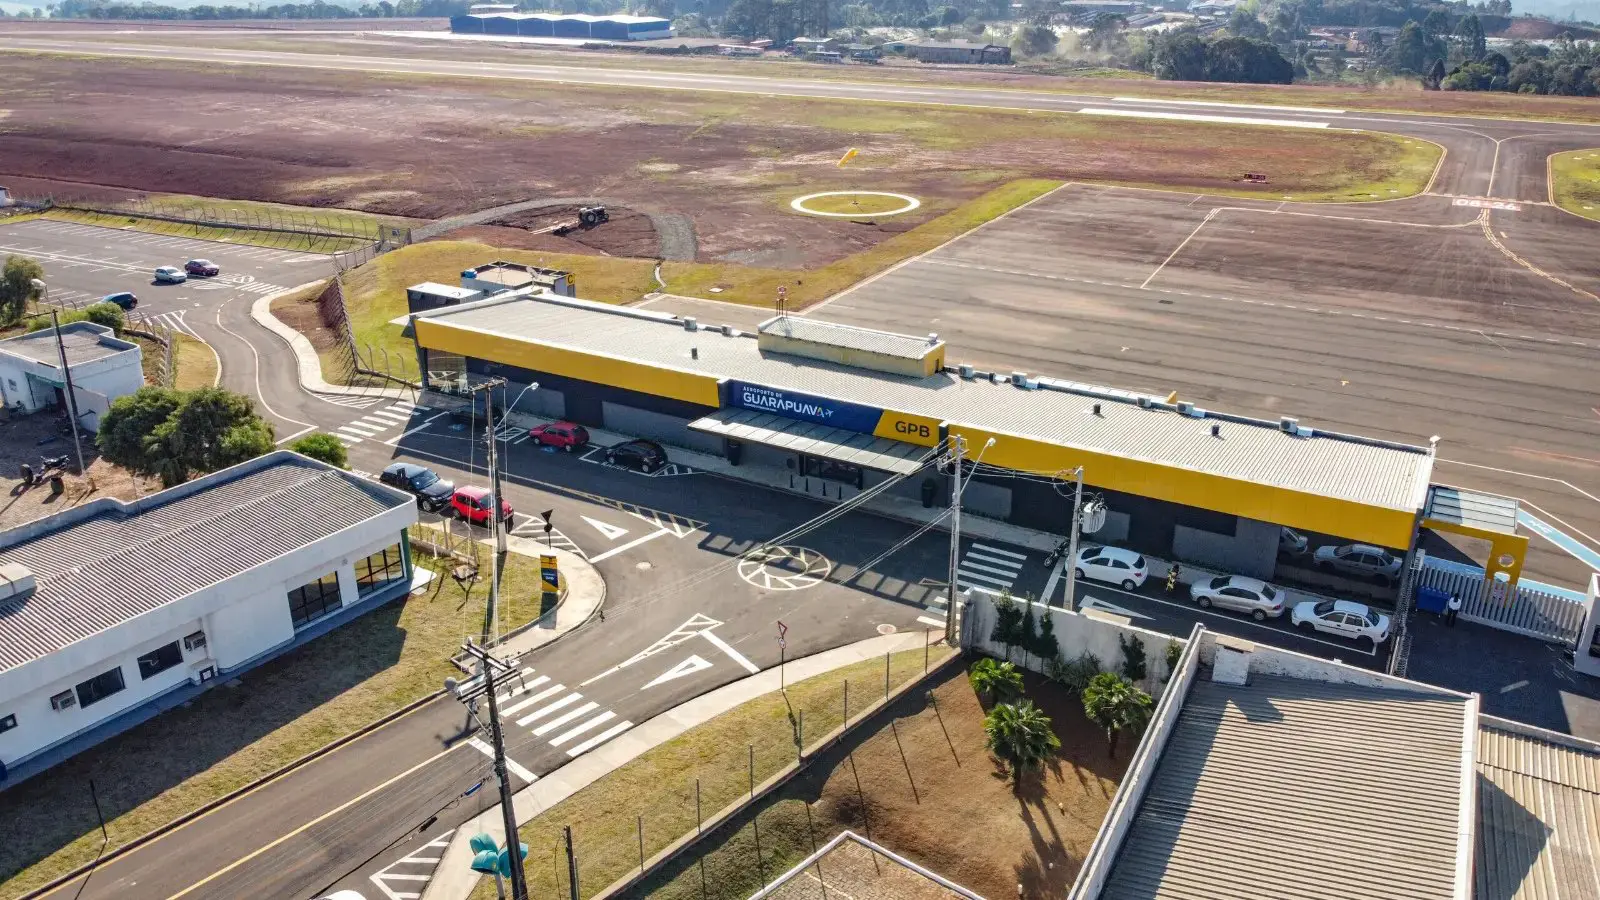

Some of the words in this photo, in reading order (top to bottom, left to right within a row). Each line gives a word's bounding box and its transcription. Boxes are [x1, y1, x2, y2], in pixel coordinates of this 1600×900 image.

[743, 386, 775, 396] AEROPORTO
[743, 392, 825, 418] GUARAPUAVA
[895, 420, 930, 438] GPB
